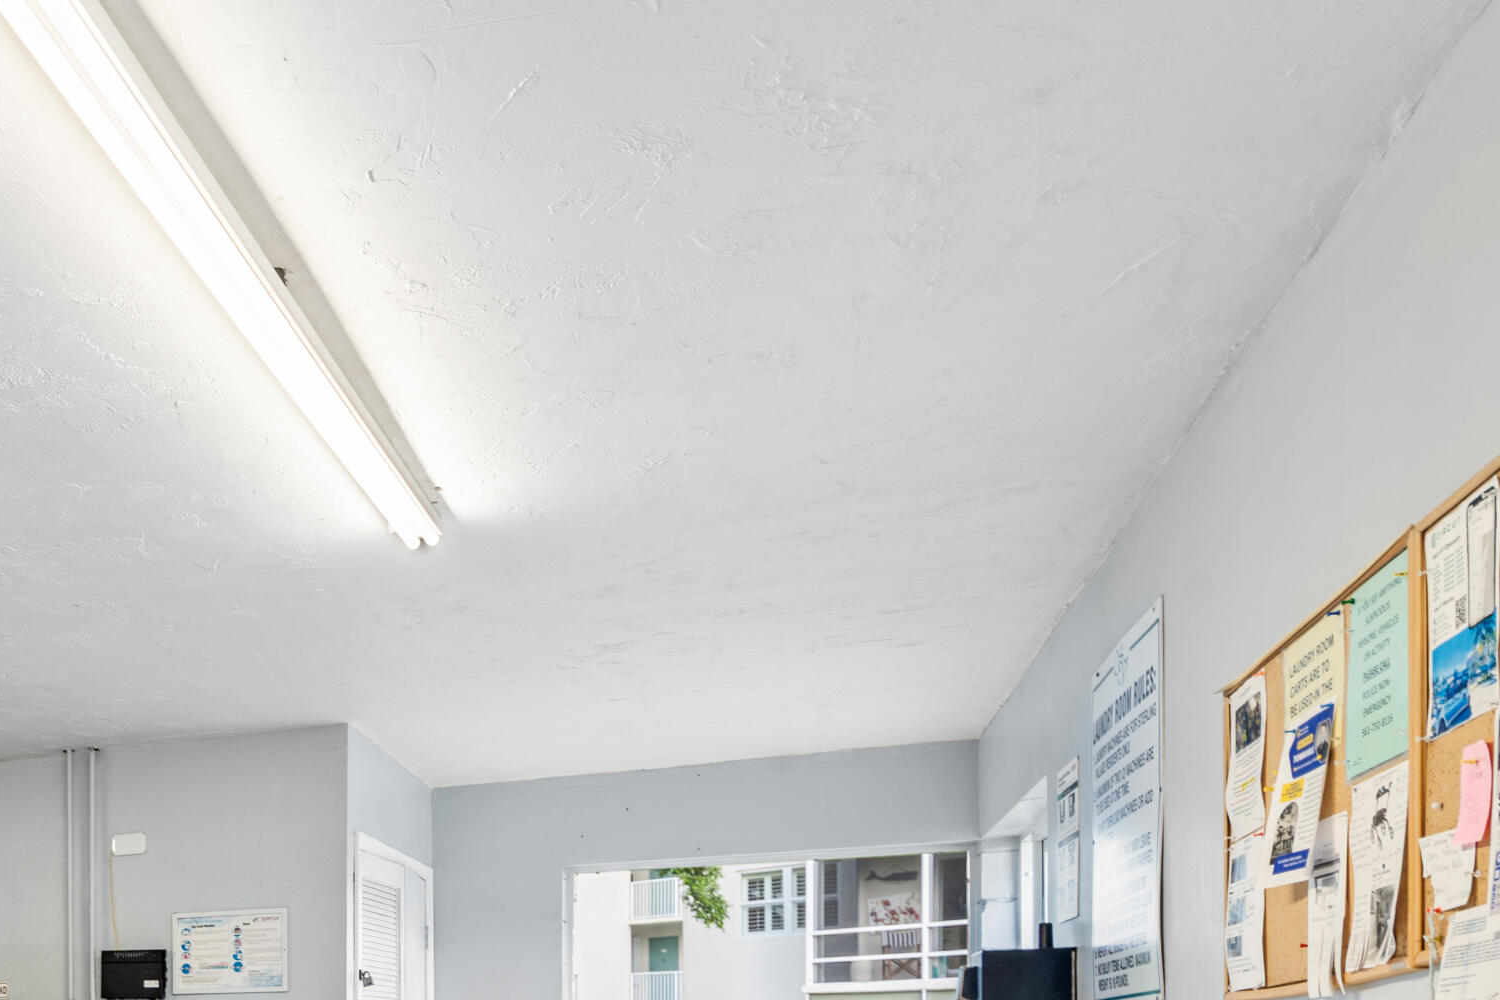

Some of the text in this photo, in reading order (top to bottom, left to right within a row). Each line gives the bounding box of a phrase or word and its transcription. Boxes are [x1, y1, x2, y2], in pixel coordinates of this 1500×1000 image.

[1289, 634, 1335, 678] LAUNDRY ROOM
[1363, 657, 1390, 681] PLEASE CALL
[1115, 686, 1131, 724] ROOM
[1133, 665, 1156, 708] RULES:
[1290, 659, 1331, 698] CARTS ARE TO
[1290, 703, 1298, 719] BE
[1320, 677, 1333, 692] THE
[1363, 694, 1392, 718] EMERGENCY
